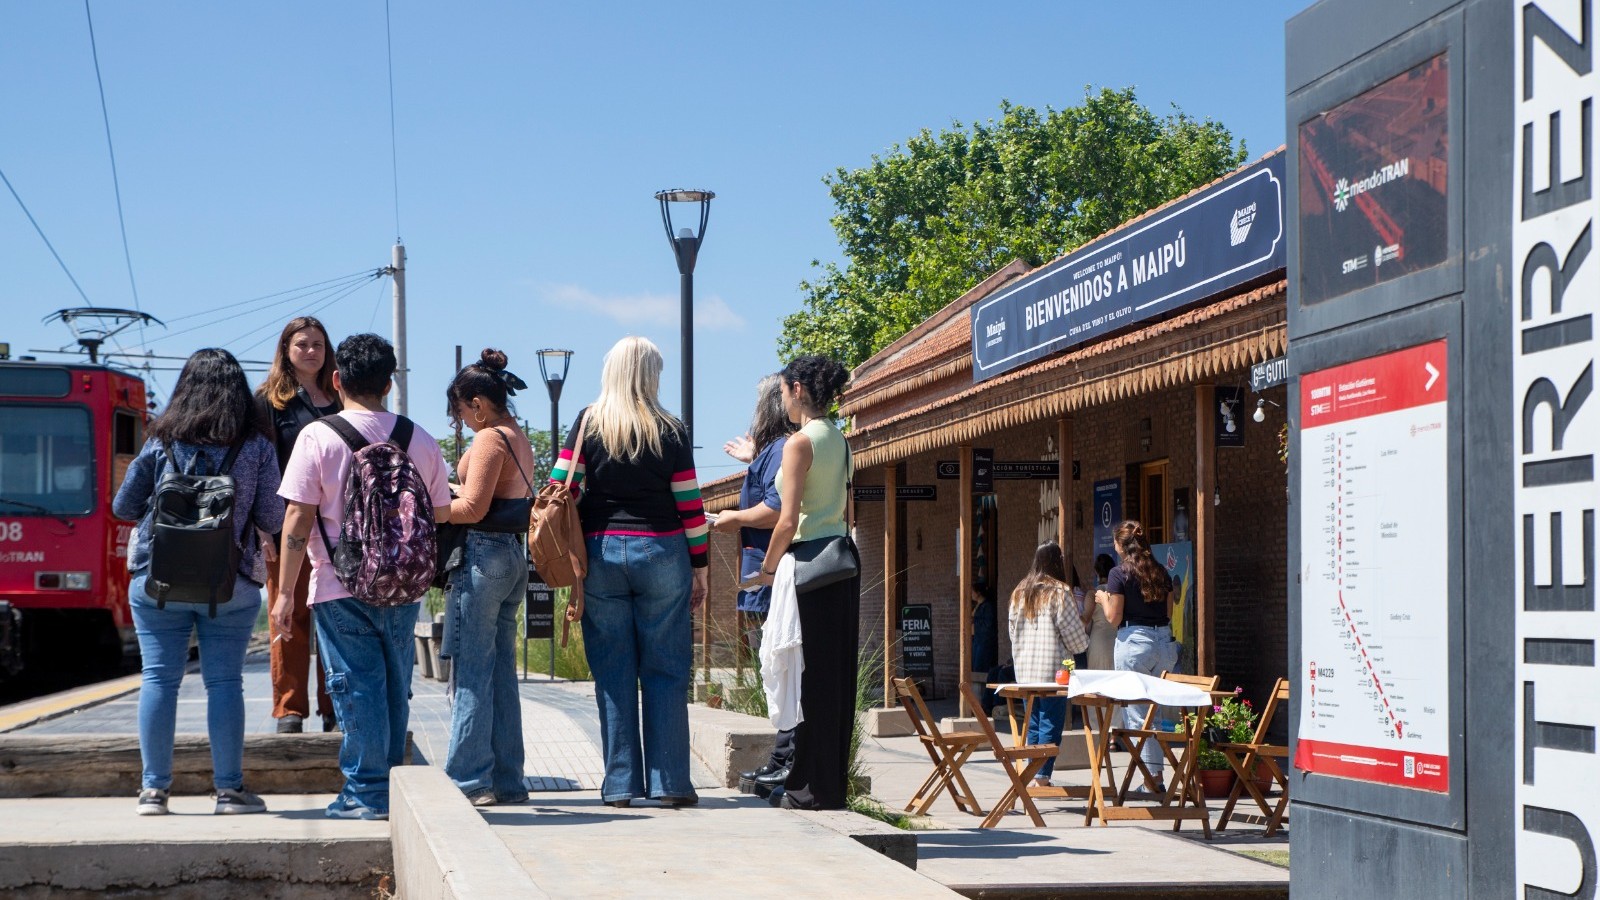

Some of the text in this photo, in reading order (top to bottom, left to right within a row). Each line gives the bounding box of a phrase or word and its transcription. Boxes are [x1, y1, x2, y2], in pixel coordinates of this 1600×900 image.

[1350, 157, 1409, 198] mendoTRAN
[1025, 230, 1186, 331] BIENVENIDOS A MAIPÚ
[1072, 264, 1096, 280] WELCOME
[1096, 262, 1104, 270] TO
[986, 316, 1006, 338] Maipú
[1068, 325, 1082, 336] CUNA
[1082, 321, 1092, 332] DEL
[1092, 316, 1104, 328] VINO
[1108, 312, 1115, 321] EL
[1116, 306, 1132, 318] OLIVO
[1266, 358, 1289, 384] GUTI
[903, 620, 930, 630] FERIA
